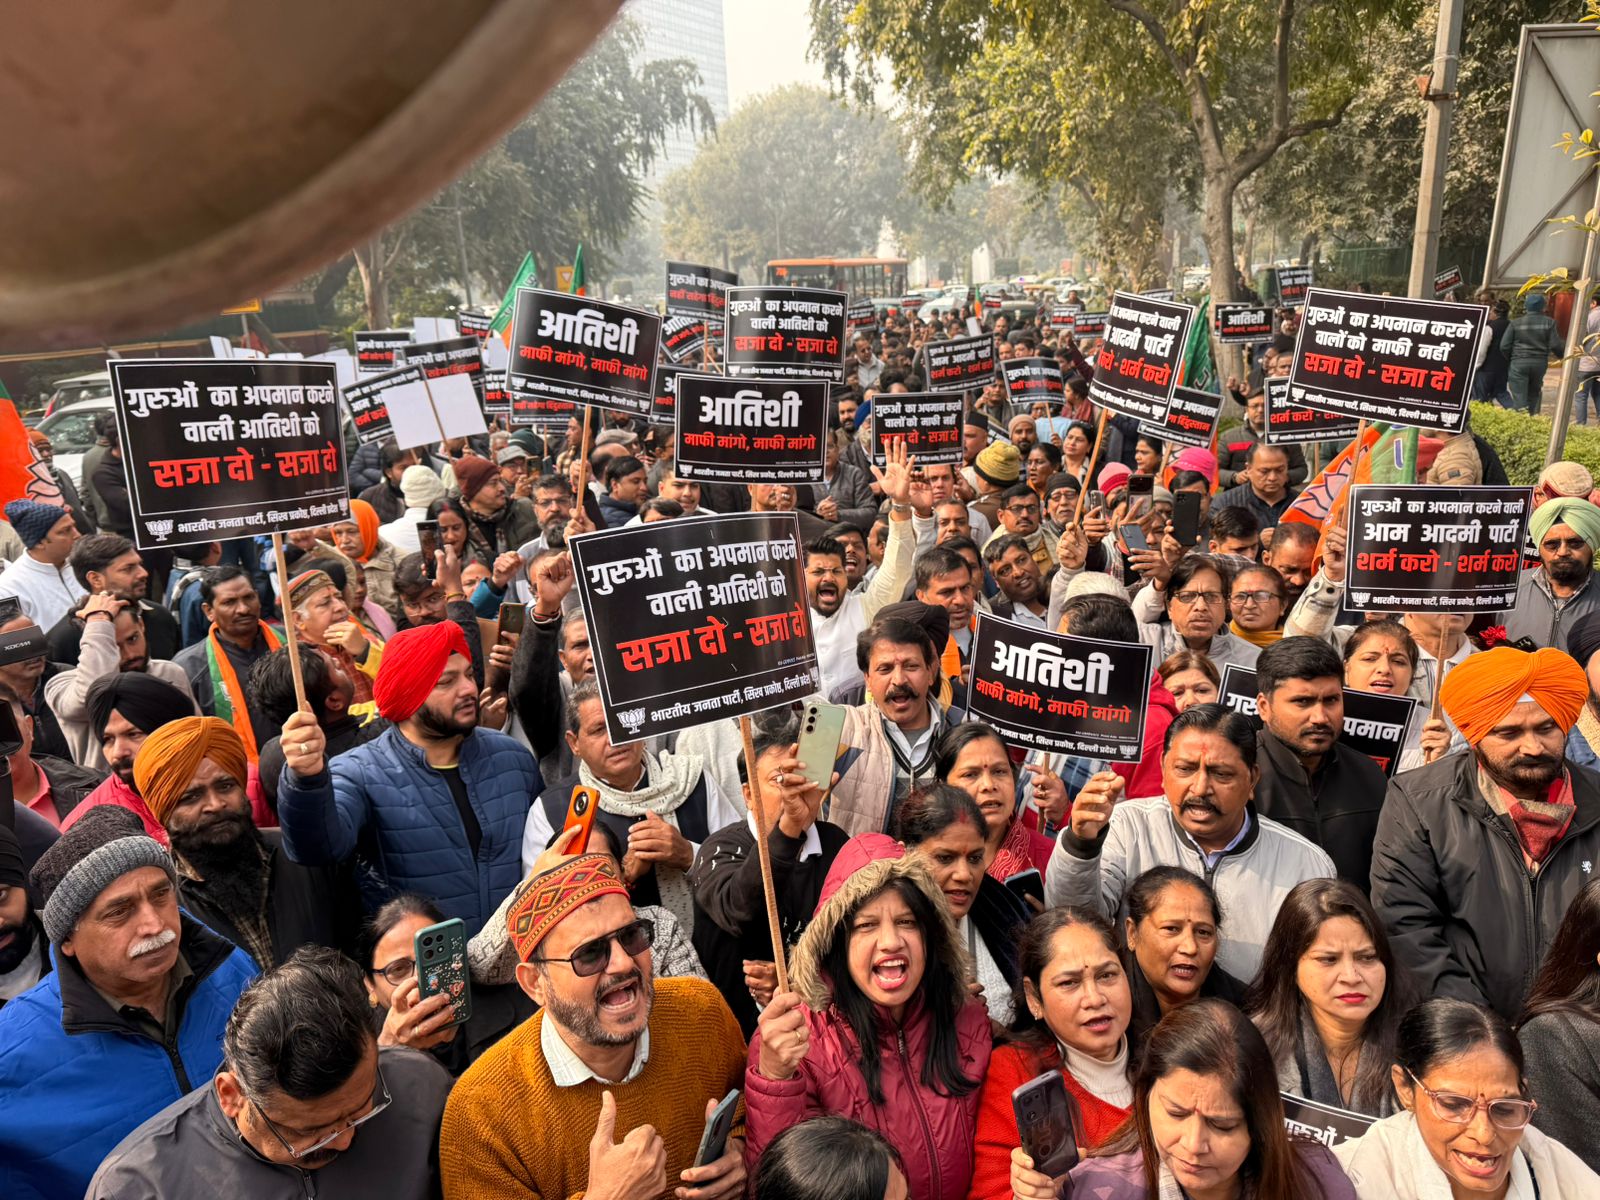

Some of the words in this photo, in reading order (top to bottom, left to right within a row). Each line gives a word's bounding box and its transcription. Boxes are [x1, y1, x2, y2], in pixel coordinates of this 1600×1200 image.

[730, 298, 761, 316] गुरुओं
[766, 302, 781, 312] का
[783, 302, 821, 312] अपमान
[822, 302, 843, 316] करने
[1139, 312, 1159, 327] करने
[1159, 315, 1181, 331] वाली
[538, 308, 640, 356] आतिशी
[750, 315, 776, 330] वाली
[778, 316, 814, 331] आतिशी
[816, 318, 828, 332] को
[1308, 306, 1346, 326] गुरुओं
[1350, 312, 1370, 328] का
[1371, 315, 1429, 335] अपमान
[1430, 320, 1474, 340] करने
[734, 336, 764, 351] सजा
[768, 332, 783, 351] दो
[796, 338, 825, 353] सजा
[826, 336, 838, 355] दो
[1110, 326, 1142, 350] आदमी
[1144, 334, 1175, 358] पार्टी
[1315, 329, 1347, 348] वालों
[1347, 333, 1368, 351] को
[1372, 337, 1413, 358] माफी
[1418, 343, 1455, 362] नहीं
[520, 345, 553, 362] माफी
[555, 350, 588, 370] मांगो,
[591, 357, 622, 375] माफी
[623, 364, 648, 381] मांगो
[1120, 357, 1144, 379] शर्म
[1143, 363, 1171, 386] करो
[1305, 352, 1344, 376] सजा
[1344, 354, 1365, 380] दो
[1381, 363, 1428, 389] सजा
[1430, 366, 1455, 392] दो
[124, 380, 199, 418] गुरुओं
[207, 386, 238, 407] का
[242, 385, 305, 406] अपमान
[305, 380, 335, 404] करने
[699, 390, 802, 427] आतिशी
[876, 402, 901, 417] गुरुओं
[904, 404, 916, 413] का
[918, 402, 945, 413] अपमान
[946, 400, 962, 411] करने
[181, 414, 235, 443] वाली
[239, 411, 301, 440] आतिशी
[303, 411, 320, 436] को
[884, 416, 906, 427] वालों
[906, 416, 918, 427] को
[921, 414, 941, 426] माफी
[943, 414, 957, 425] नहीं
[1270, 409, 1290, 423] शर्म
[684, 432, 715, 447] माफी
[717, 433, 750, 451] मांगो,
[752, 434, 785, 450] माफी
[787, 434, 816, 450] मांगो
[907, 429, 919, 444] दो
[928, 430, 949, 442] सजा
[950, 428, 959, 441] दो
[149, 456, 220, 488] सजा
[223, 447, 254, 482] दो
[275, 448, 321, 478] सजा
[320, 441, 338, 473] दो
[178, 518, 216, 534] भारतीय
[218, 516, 245, 530] जनता
[245, 511, 267, 526] पार्टी,
[267, 510, 288, 524] सिख
[310, 504, 326, 518] दिल्ली
[1361, 498, 1402, 516] गुरुओं
[1407, 501, 1425, 514] का
[1428, 501, 1475, 515] अपमान
[1476, 499, 1503, 514] करने
[1504, 498, 1524, 514] वाली
[1363, 523, 1411, 543] आम
[1421, 519, 1482, 543] आदमी
[1488, 518, 1520, 543] पार्टी
[587, 548, 663, 596] गुरुओं
[671, 547, 704, 574] का
[708, 540, 769, 569] अपमान
[769, 533, 798, 561] करने
[1356, 548, 1398, 572] शर्म
[1400, 549, 1440, 572] करो
[1457, 549, 1491, 573] शर्म
[1492, 550, 1518, 572] करो
[646, 579, 704, 617] वाली
[707, 570, 768, 607] आतिशी
[769, 569, 787, 598] को
[1372, 596, 1400, 606] भारतीय
[616, 629, 693, 673] सजा
[694, 615, 728, 656] दो
[745, 610, 792, 647] सजा
[790, 601, 807, 638] दो
[991, 640, 1114, 695] आतिशी
[651, 704, 691, 722] भारतीय
[693, 697, 721, 712] जनता
[722, 688, 744, 706] पार्टी,
[744, 686, 764, 702] सिख
[764, 681, 785, 697] प्रकोष्ठ,
[784, 676, 800, 693] दिल्ली
[976, 678, 1004, 701] माफी
[1005, 689, 1044, 714] मांगो,
[1047, 698, 1090, 719] माफी
[1091, 705, 1132, 724] मांगो
[1036, 735, 1053, 747] सिख
[1077, 741, 1099, 754] दिल्ली
[1343, 717, 1404, 743] पमान
